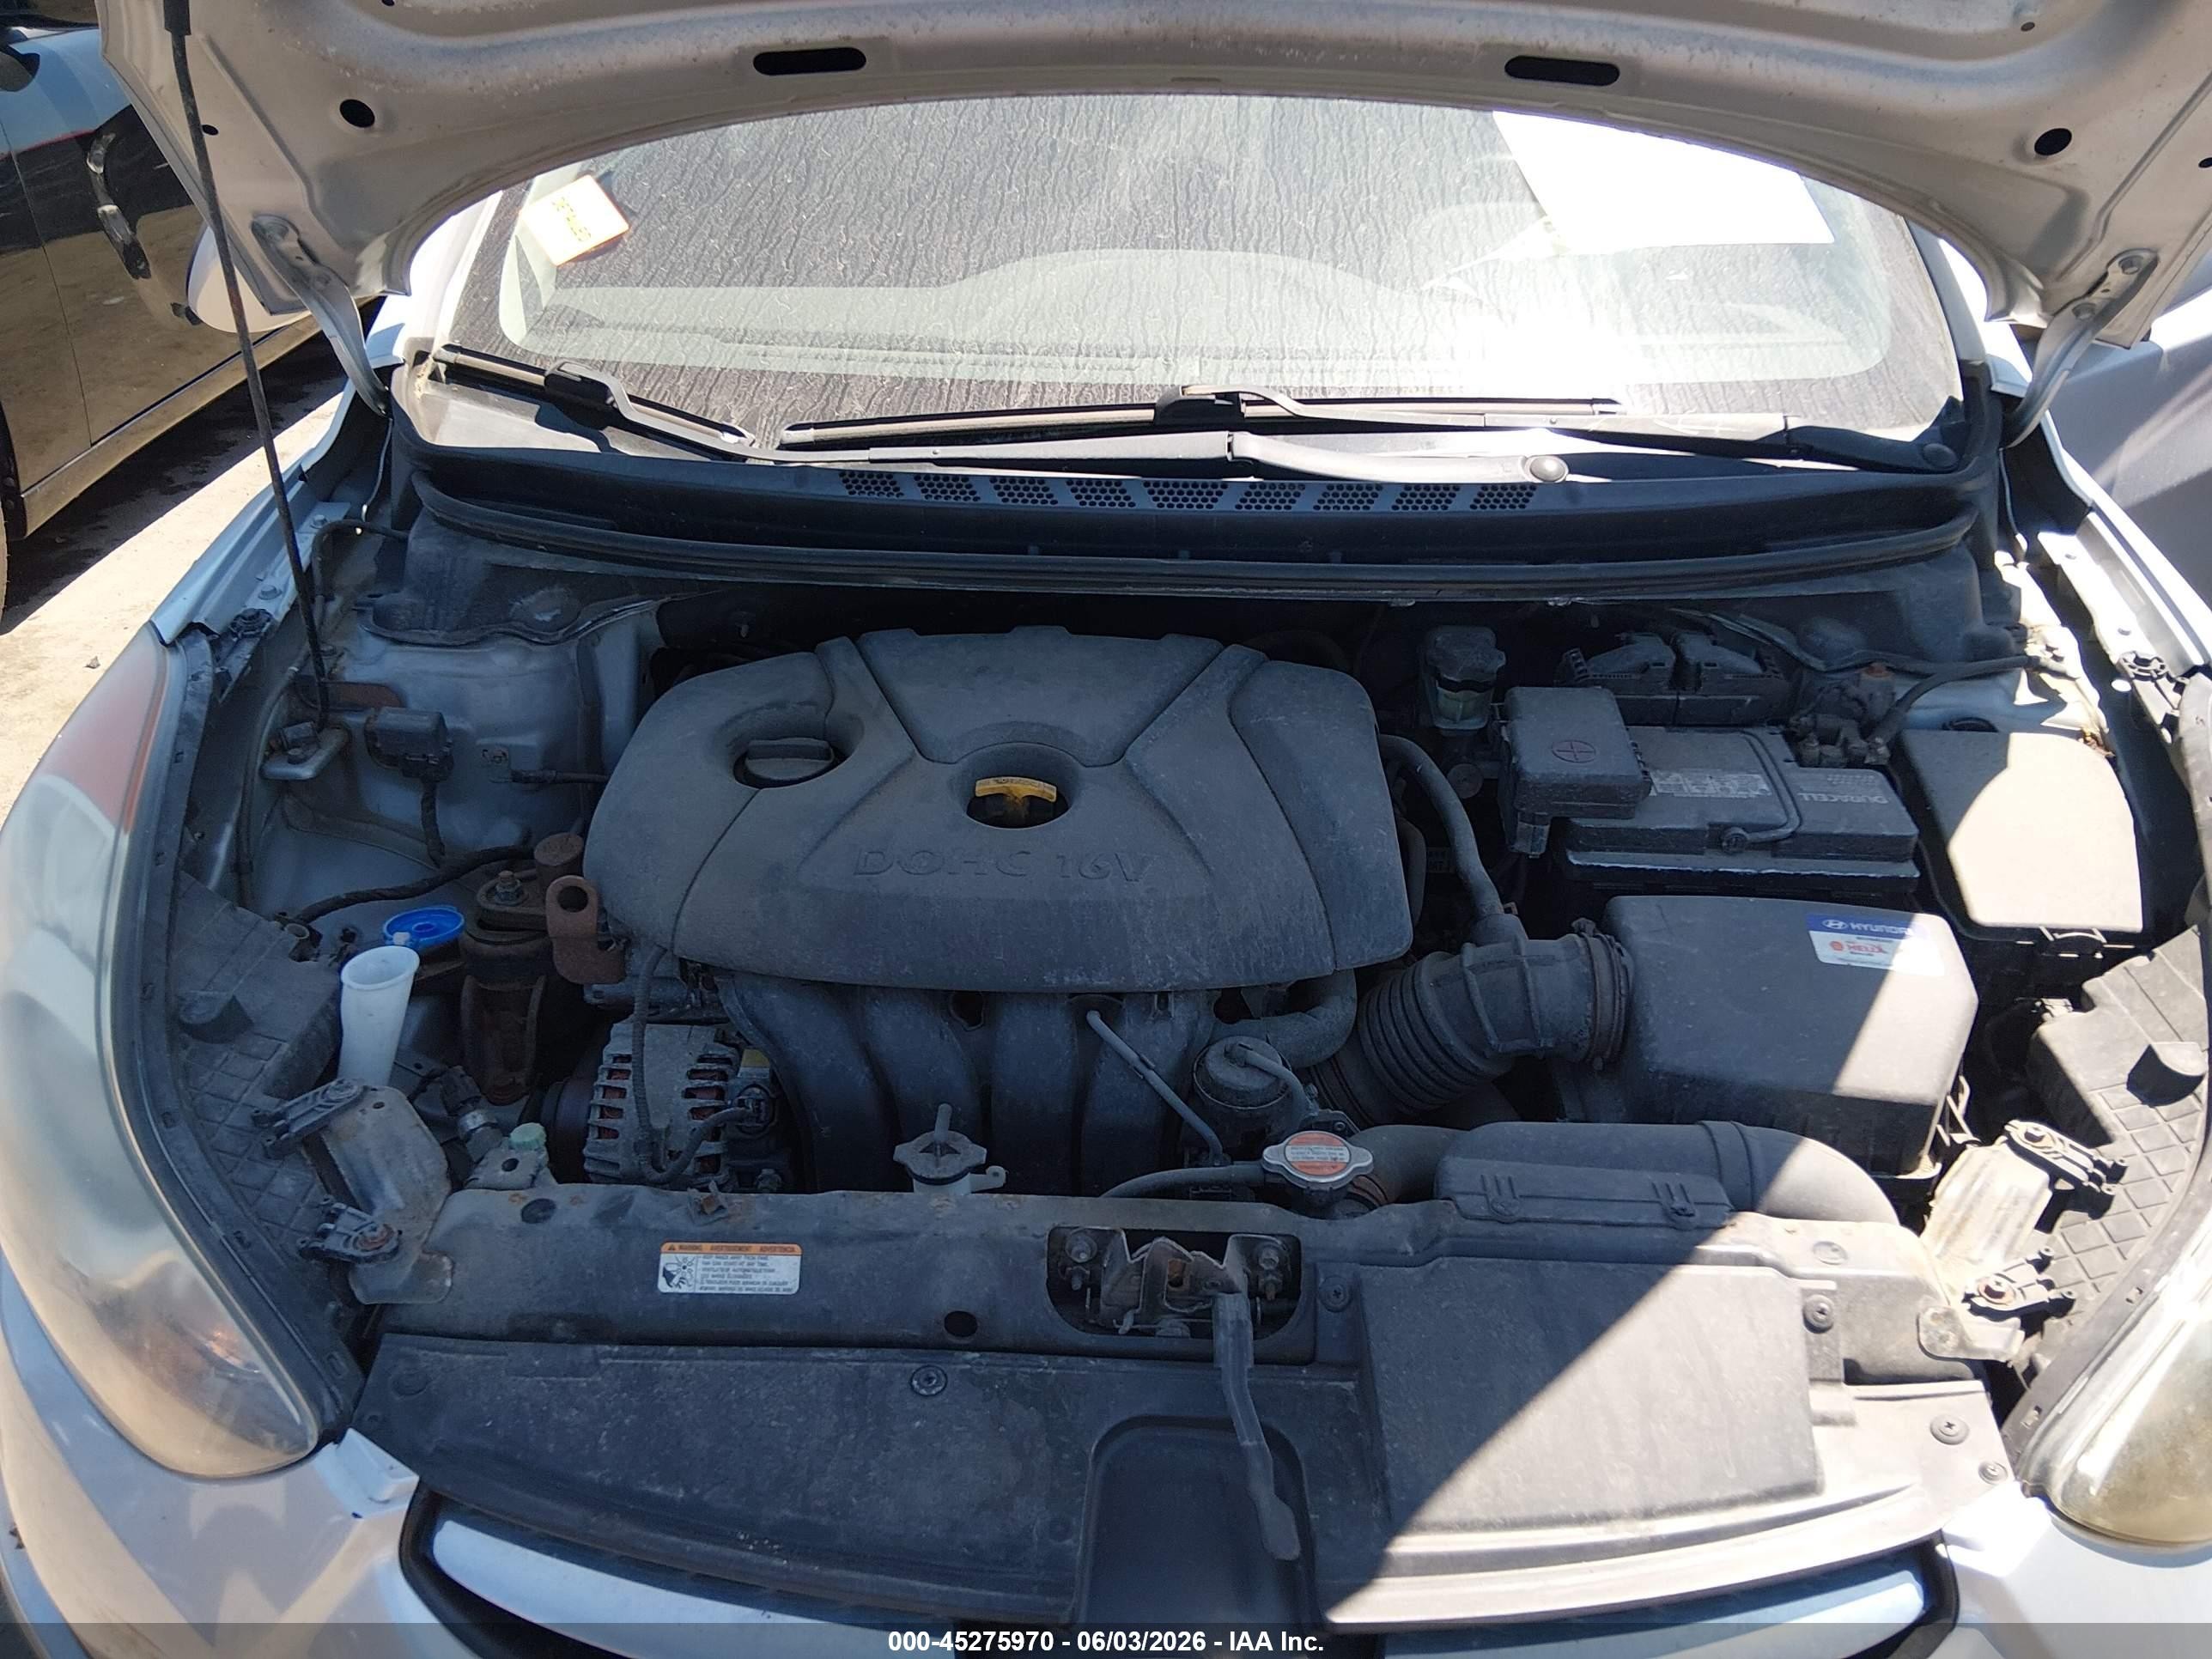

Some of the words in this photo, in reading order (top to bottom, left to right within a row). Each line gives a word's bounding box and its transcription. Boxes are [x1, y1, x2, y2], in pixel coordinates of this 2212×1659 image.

[1797, 793, 1888, 805] DURACELL
[854, 849, 1032, 878] DOHC
[1056, 853, 1157, 882] 16V
